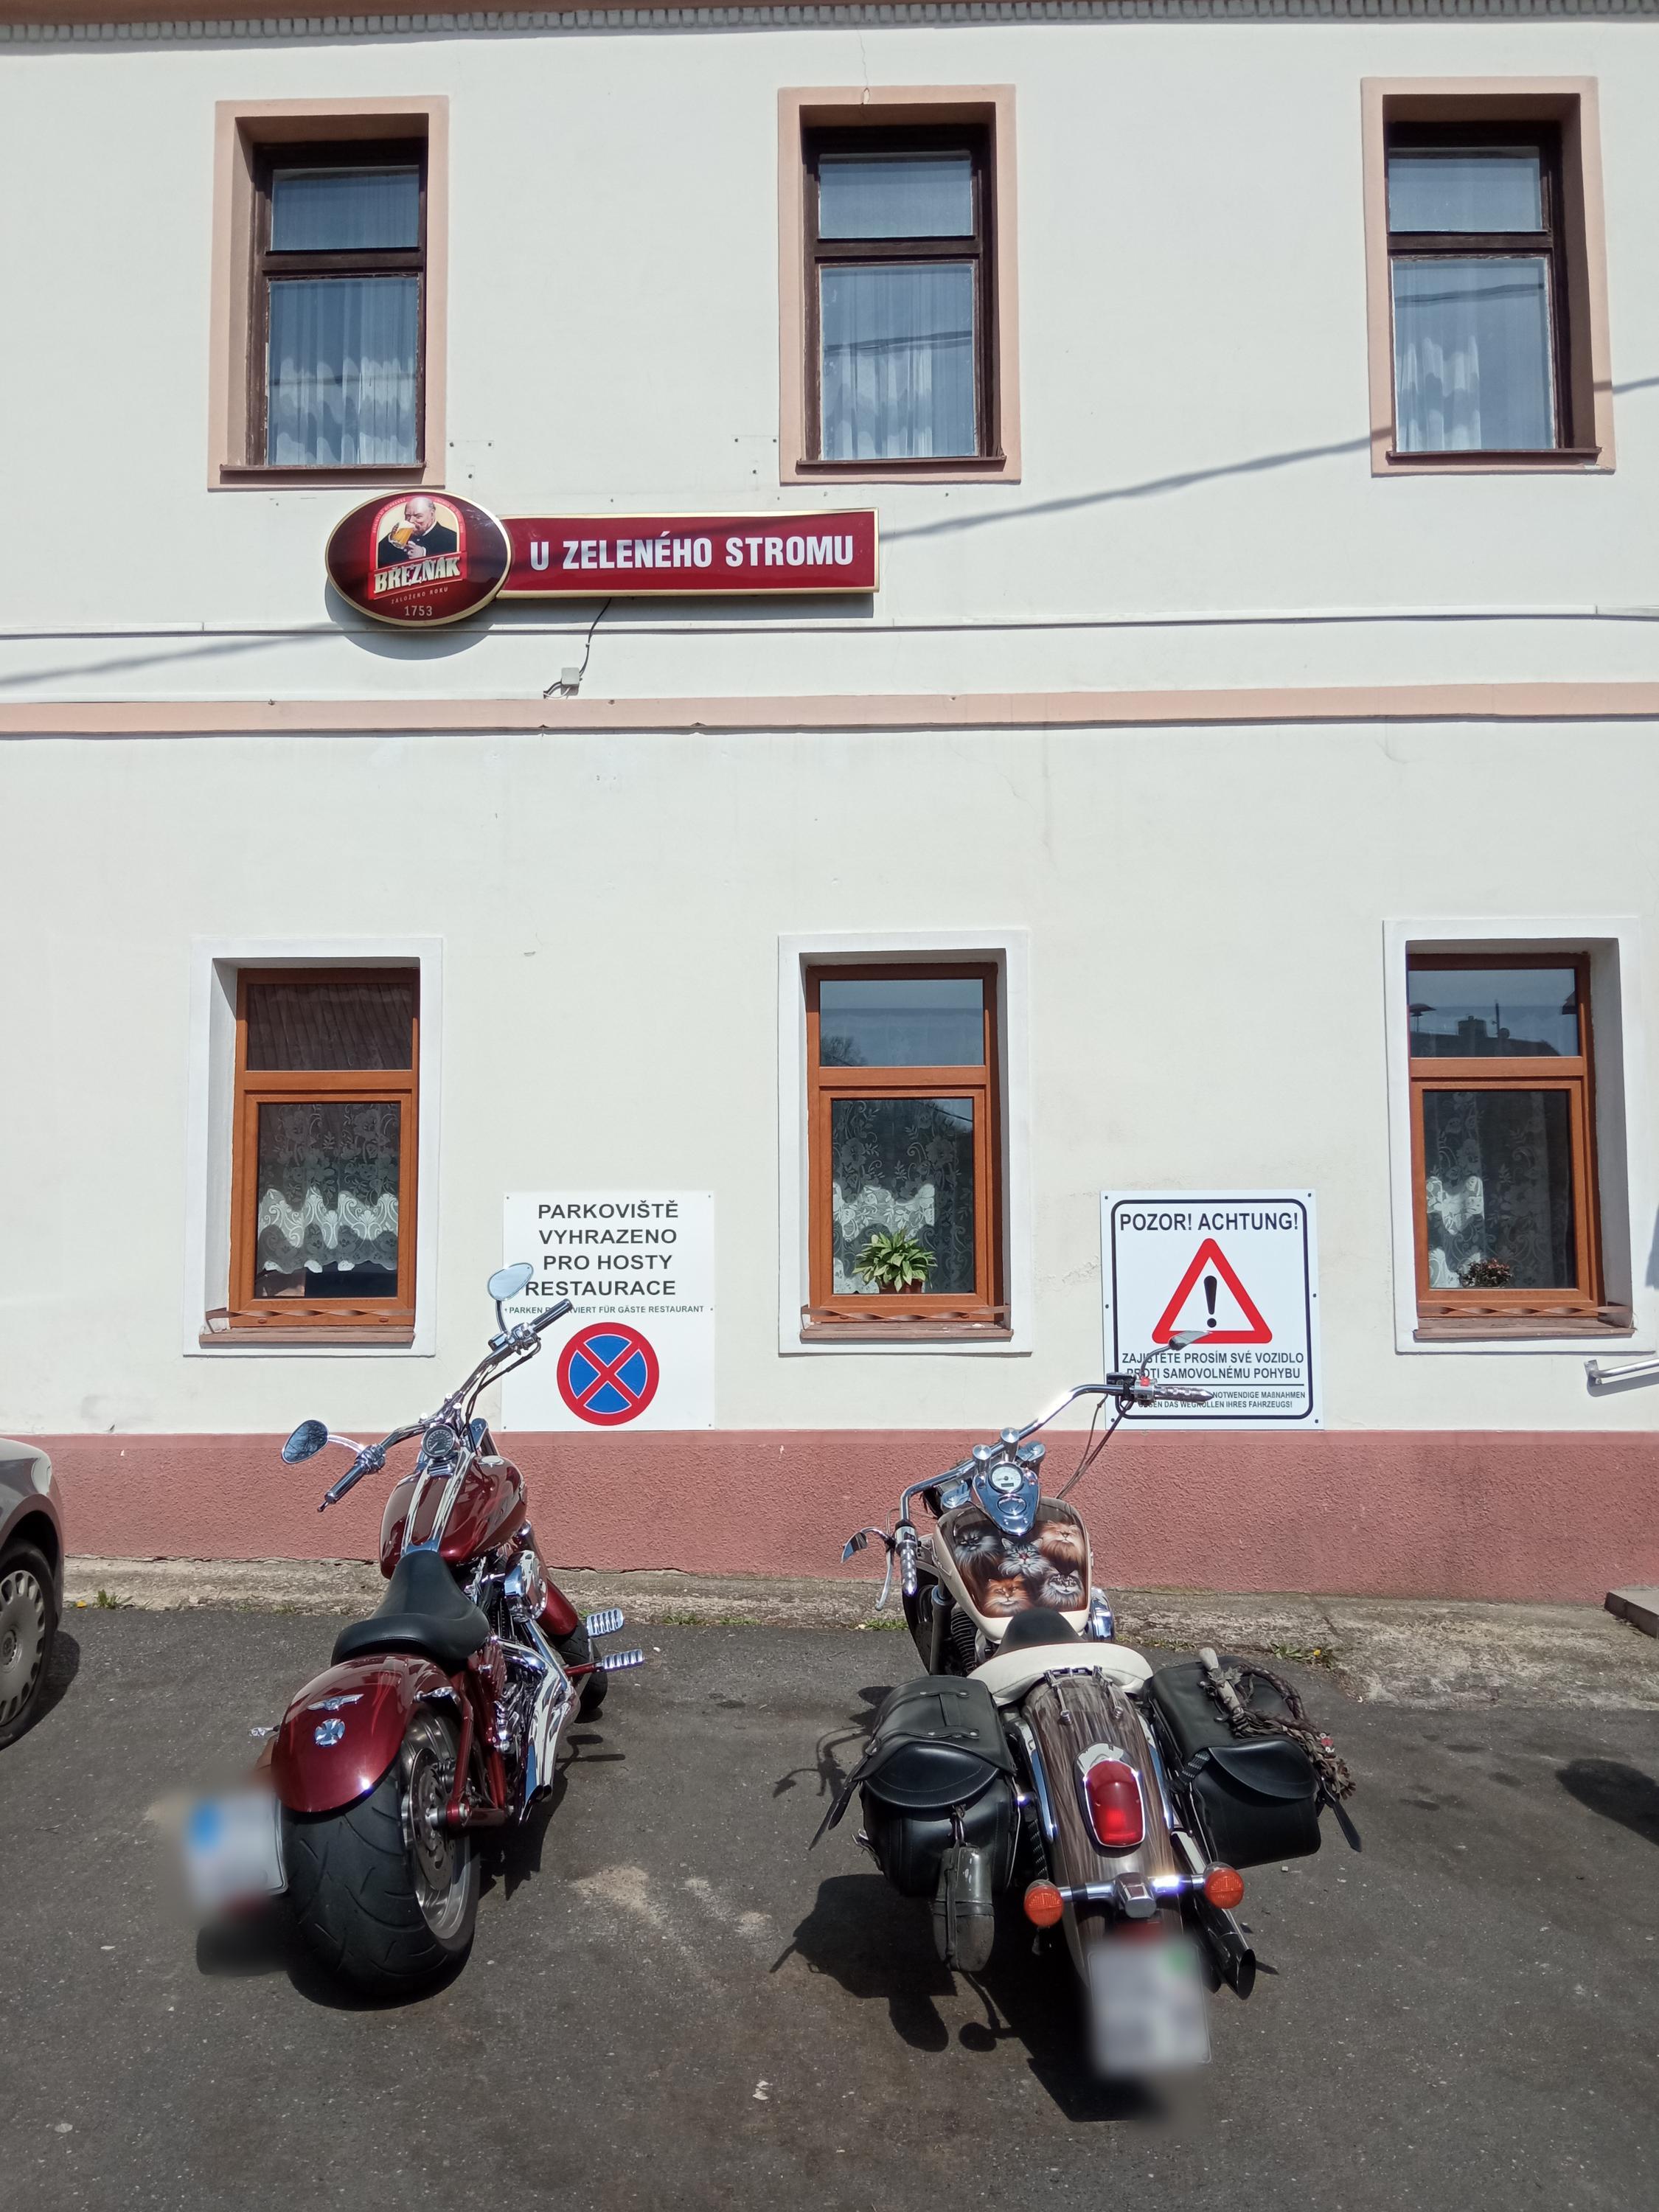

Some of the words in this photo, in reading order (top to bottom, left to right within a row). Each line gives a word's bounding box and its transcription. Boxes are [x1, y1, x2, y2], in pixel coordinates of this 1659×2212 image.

[530, 540, 549, 571] U
[563, 531, 712, 570] ZELENÉHO
[725, 535, 854, 567] STROMU
[429, 586, 449, 596] ROKU
[404, 605, 433, 616] 1753
[538, 1200, 678, 1219] PARKOVIŠTĚ
[1120, 1214, 1192, 1231] POZOR!
[1197, 1213, 1298, 1231] ACHTUNG!
[538, 1228, 677, 1245] VYHRAZENO
[543, 1255, 590, 1270] PRO
[597, 1254, 673, 1270] HOSTY
[525, 1280, 676, 1296] RESTAURACE
[599, 1305, 616, 1313] FÜR
[617, 1304, 646, 1313] GÄSTE
[648, 1305, 704, 1313] RESTAURANT
[1184, 1351, 1227, 1363] PROSÍM
[1230, 1350, 1252, 1363] SVÉ
[1255, 1352, 1304, 1363] VOZIDLO
[1164, 1366, 1251, 1379] SAMOVOLNÉMU
[1254, 1368, 1301, 1378] POHYBU
[1165, 1400, 1179, 1408] DAS
